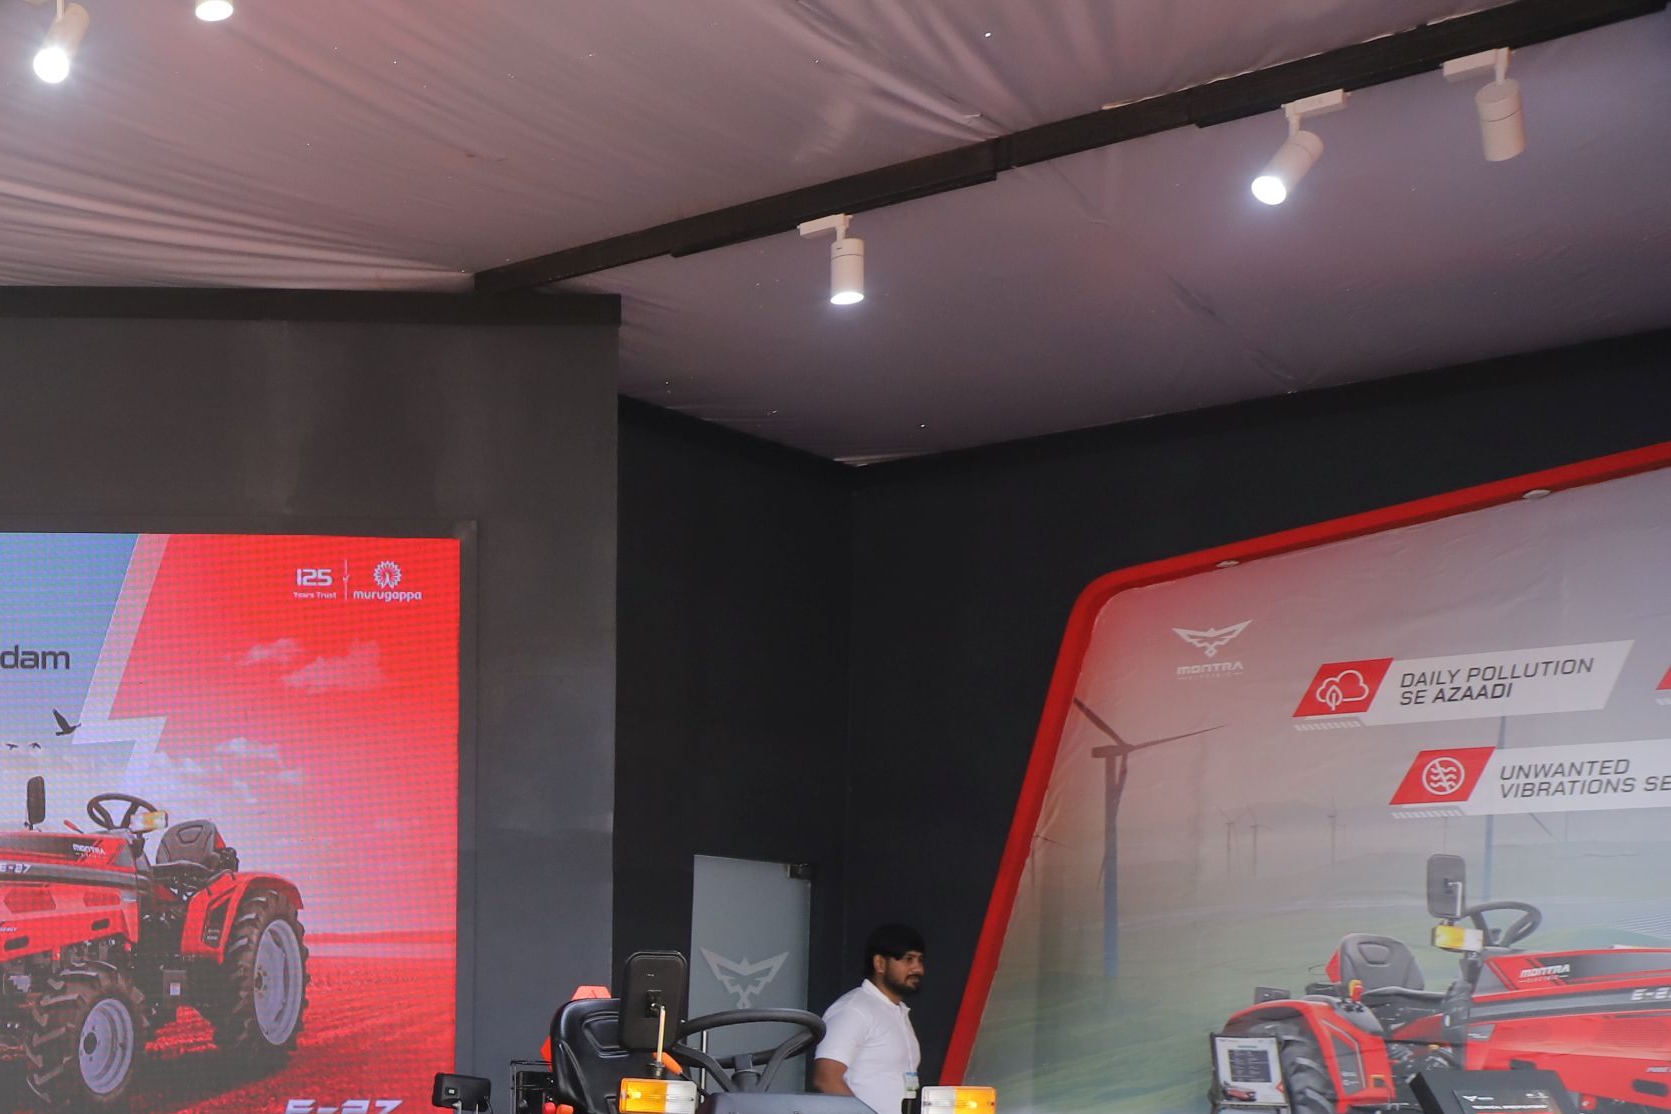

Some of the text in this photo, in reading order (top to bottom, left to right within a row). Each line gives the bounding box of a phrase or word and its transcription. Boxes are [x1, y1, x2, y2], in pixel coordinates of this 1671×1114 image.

[296, 568, 333, 587] 125
[353, 590, 423, 602] murugappa
[1177, 661, 1244, 675] MONTRA
[1400, 658, 1594, 688] DAILY POLLUTION
[1399, 682, 1513, 706] SE AZAADI
[1499, 758, 1631, 781] UNWANTED
[1500, 777, 1636, 799] VIBRATIONS
[1519, 964, 1571, 978] MONTRA
[1631, 986, 1671, 1002] E-2
